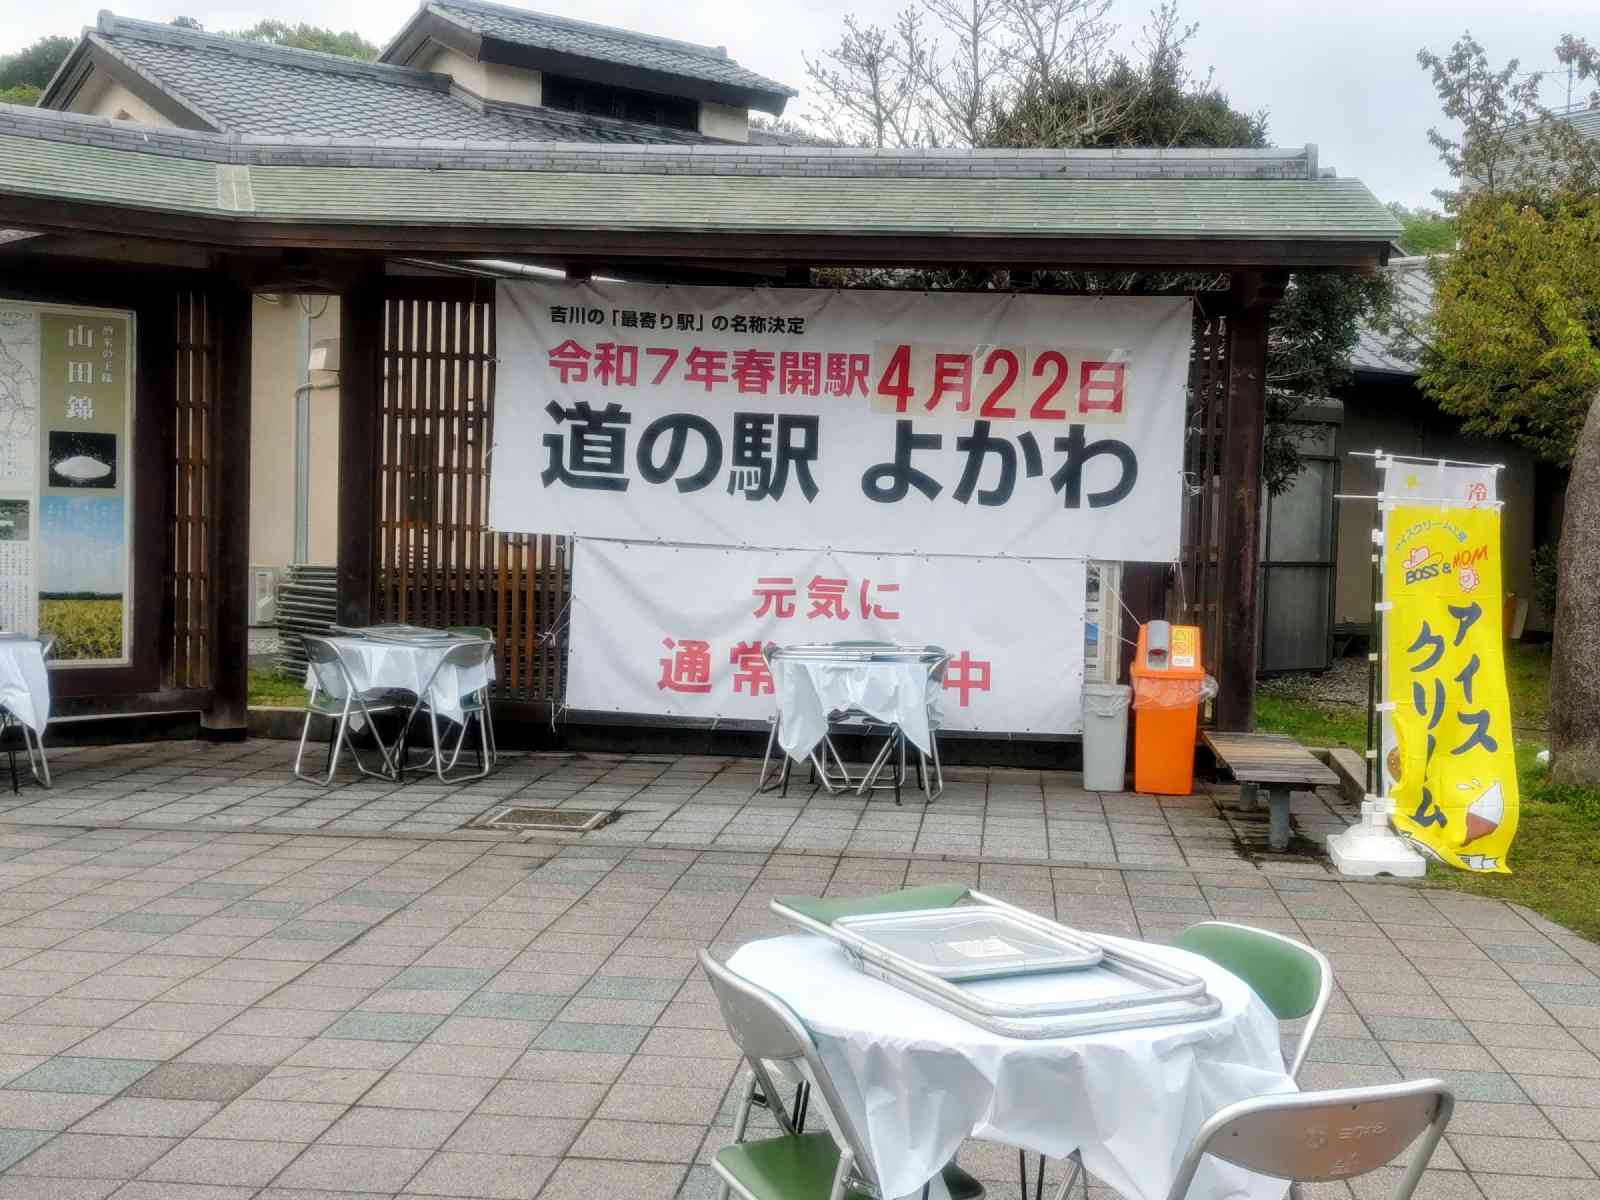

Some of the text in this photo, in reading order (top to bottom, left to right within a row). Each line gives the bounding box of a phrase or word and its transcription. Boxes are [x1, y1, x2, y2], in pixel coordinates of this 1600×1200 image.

[550, 305, 805, 334] 吉川の「最寄り駅」の名称決定
[66, 323, 94, 420] 山田錦
[541, 399, 1138, 509] 道の駅 よかわ
[751, 575, 900, 619] 元気に
[1405, 563, 1439, 585] BOSS
[1442, 562, 1452, 574] &
[1407, 619, 1448, 829] クリーム
[1447, 601, 1498, 756] アイス
